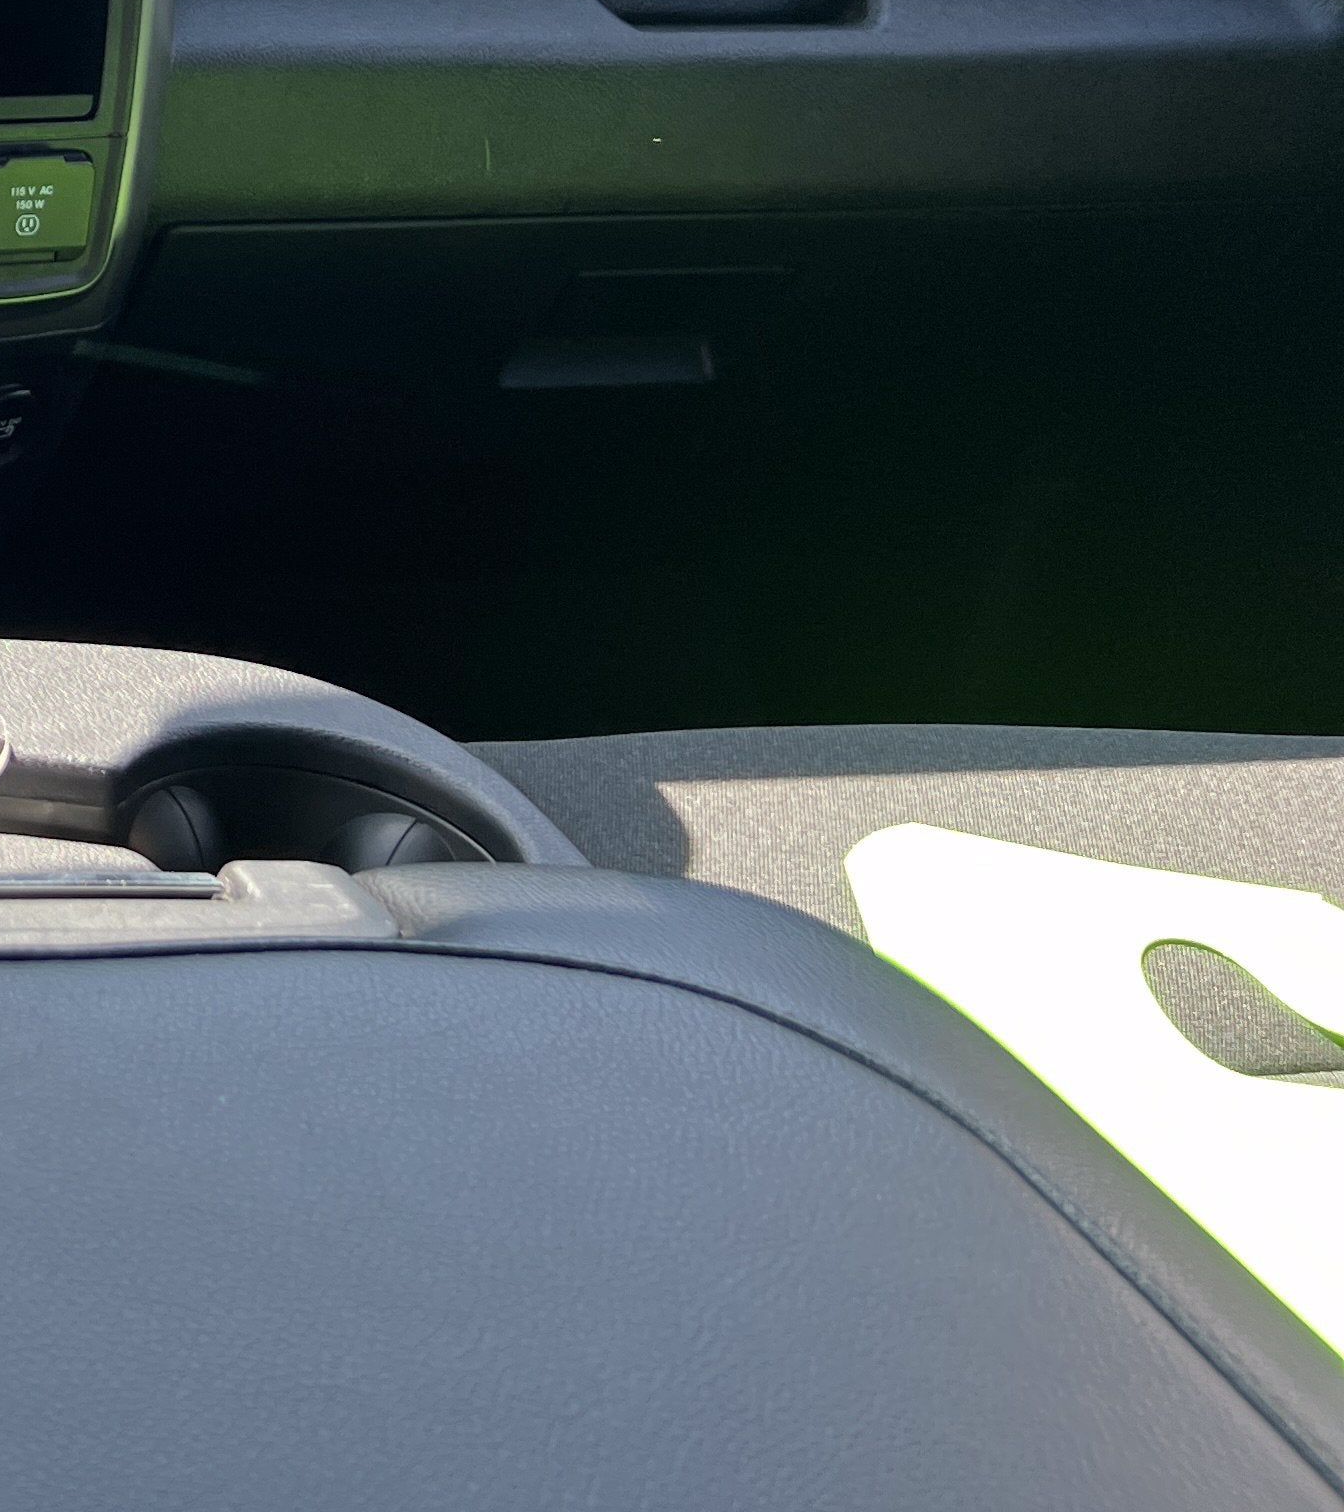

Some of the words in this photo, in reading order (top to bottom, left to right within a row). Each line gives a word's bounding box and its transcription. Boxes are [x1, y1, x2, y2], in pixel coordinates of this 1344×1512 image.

[27, 186, 36, 196] V
[39, 185, 54, 195] AC
[34, 199, 45, 209] W
